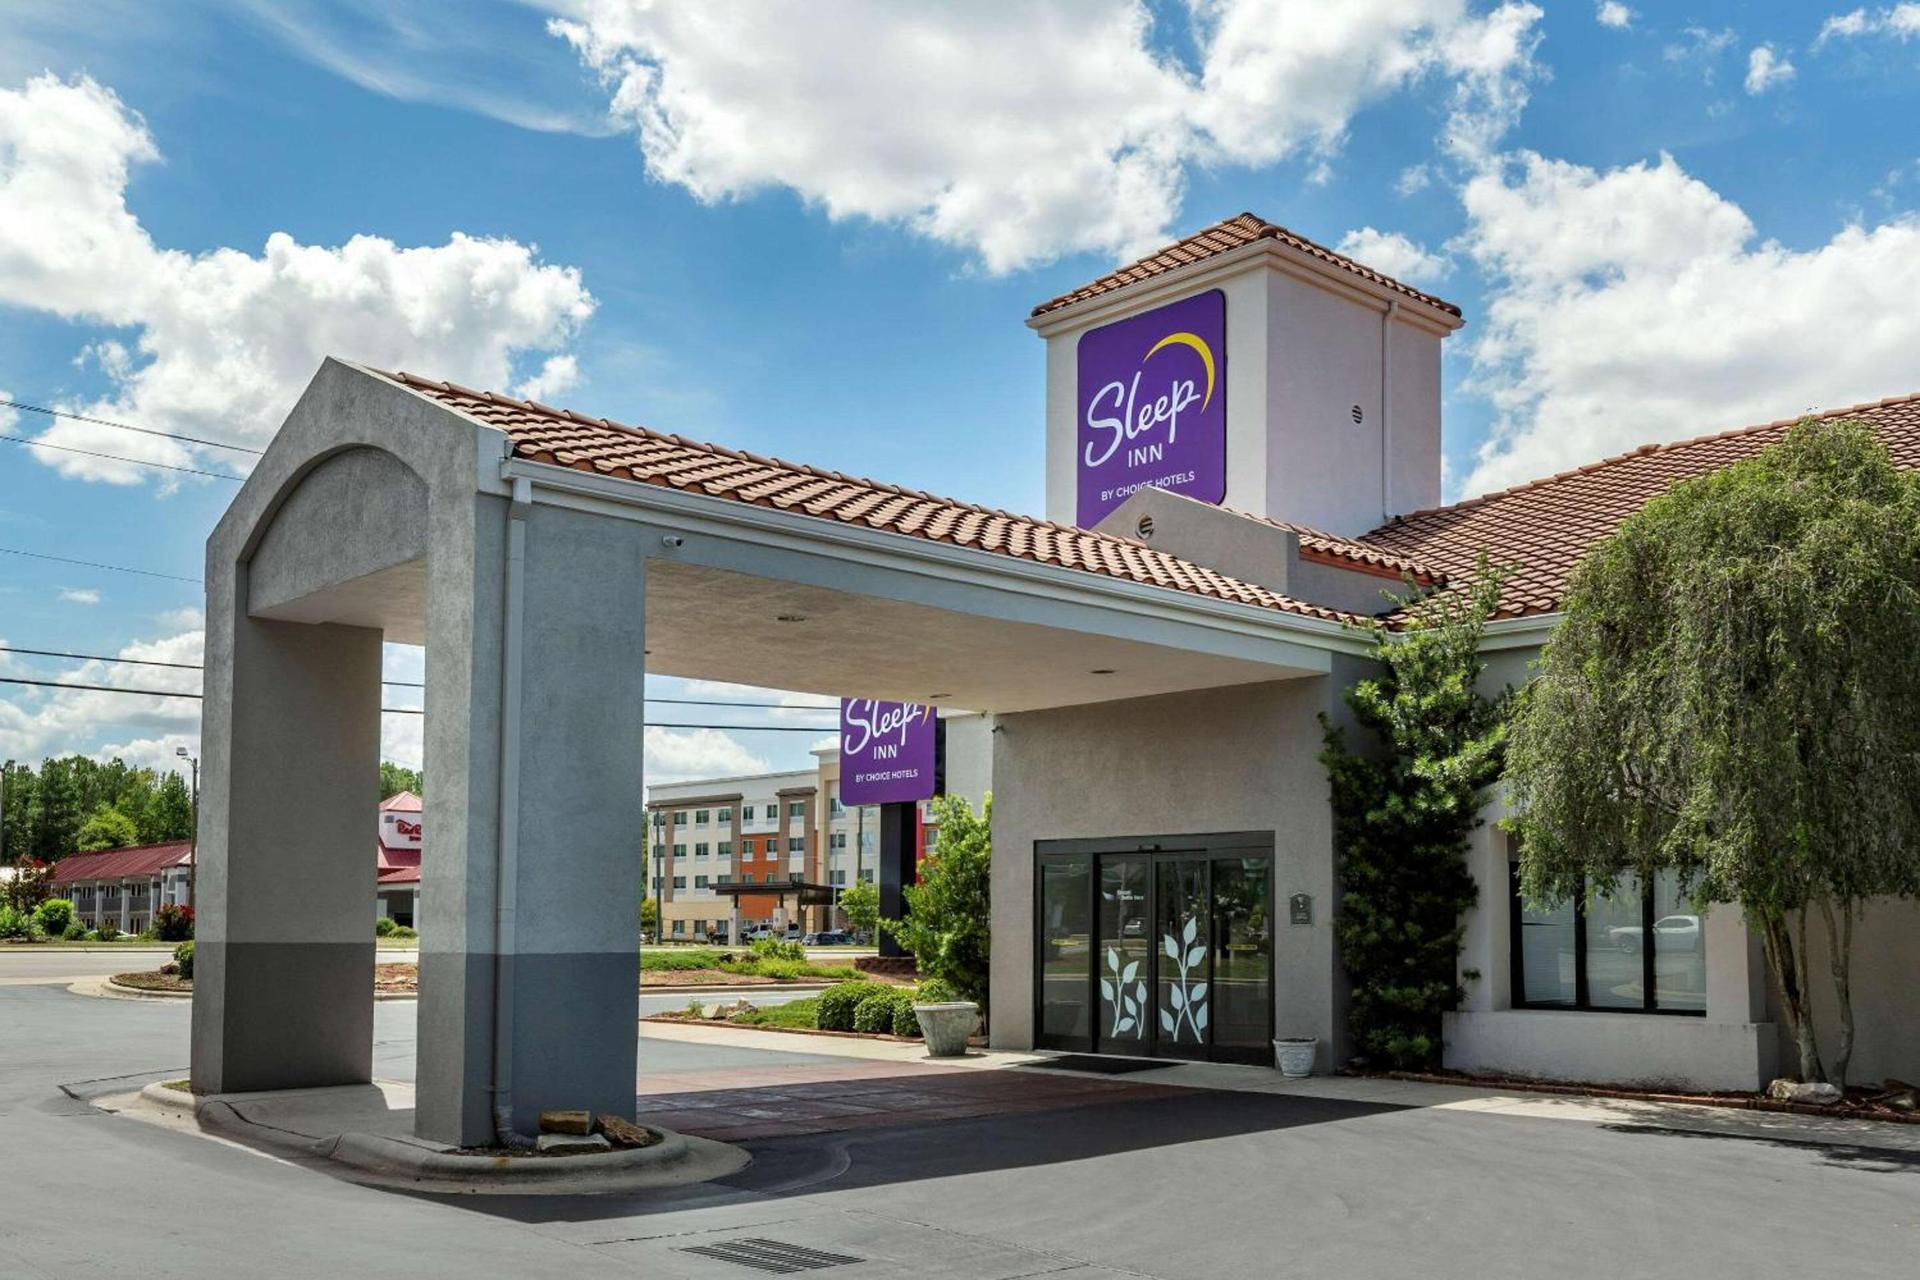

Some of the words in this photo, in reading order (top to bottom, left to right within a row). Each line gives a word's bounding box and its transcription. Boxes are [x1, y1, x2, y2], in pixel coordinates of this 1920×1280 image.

[1085, 371, 1200, 467] Sleep
[1128, 443, 1162, 468] INN
[1101, 489, 1114, 501] BY
[1155, 470, 1195, 489] HOTELS
[844, 698, 922, 755] Sleep
[873, 744, 897, 760] INN
[855, 774, 865, 782] BY
[866, 771, 890, 781] CHOICE
[891, 768, 918, 779] HOTELS
